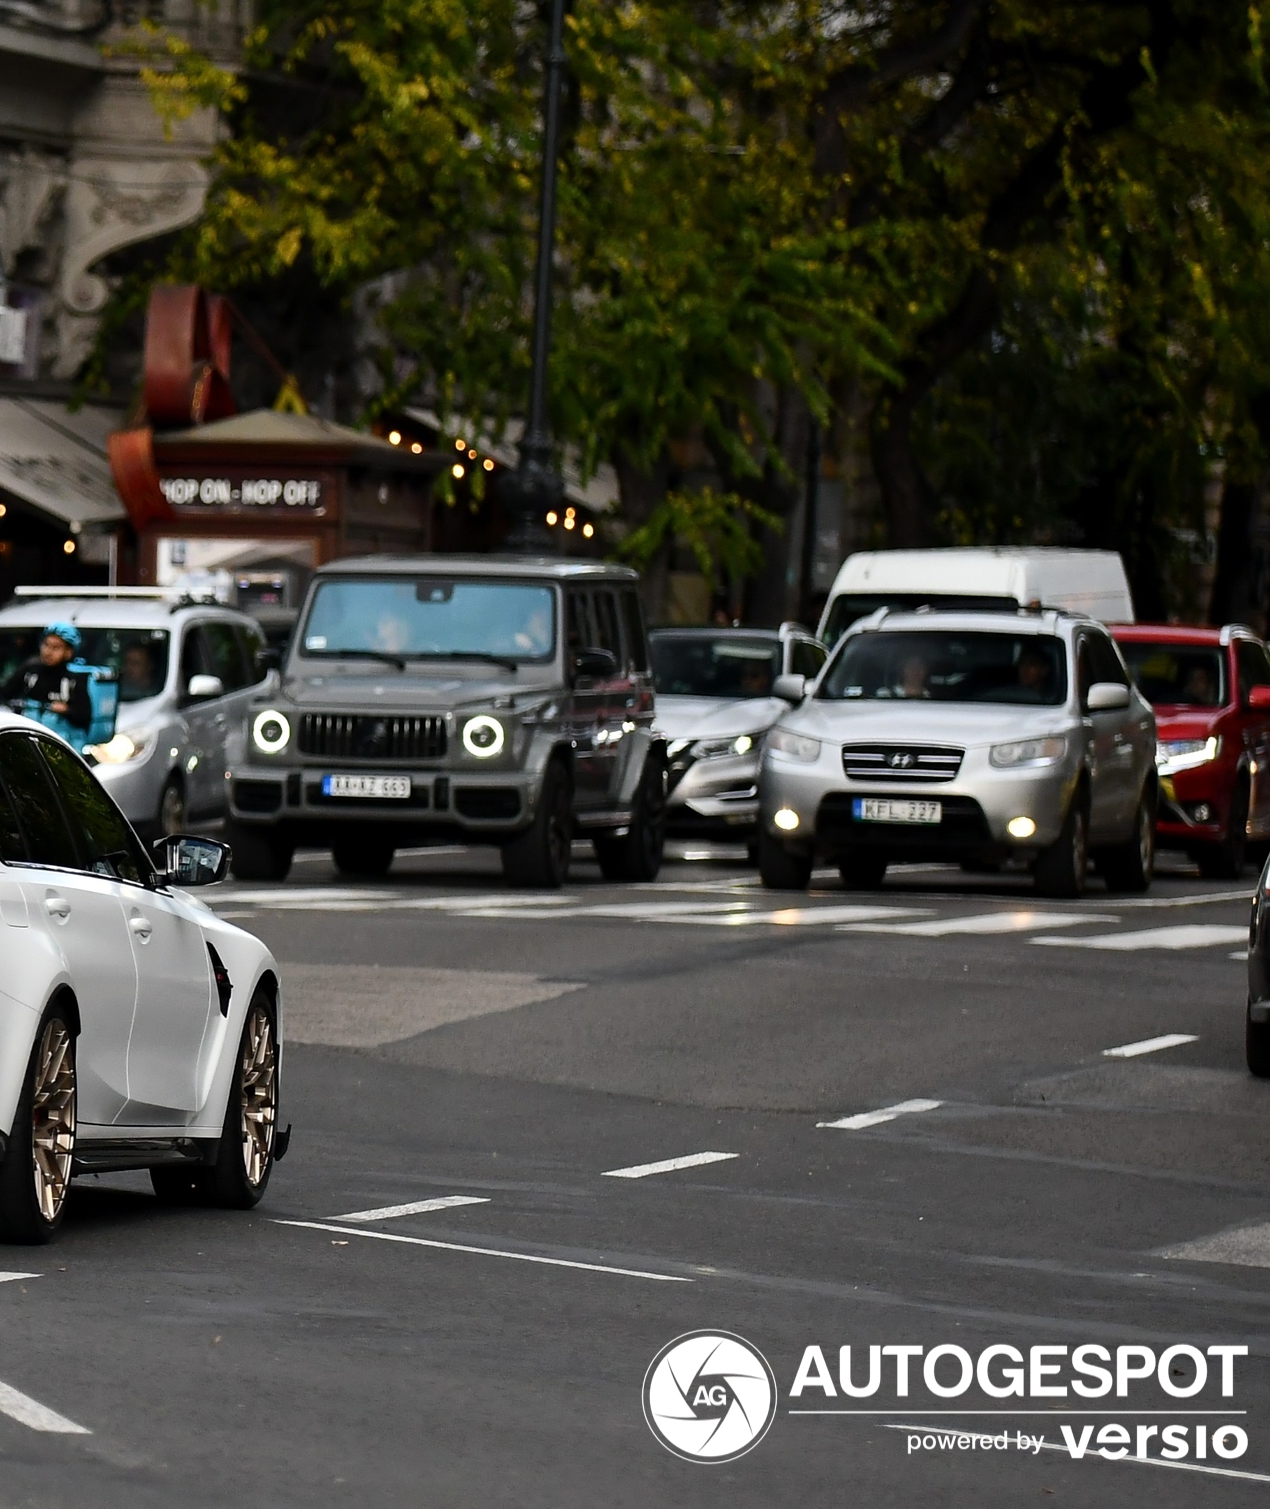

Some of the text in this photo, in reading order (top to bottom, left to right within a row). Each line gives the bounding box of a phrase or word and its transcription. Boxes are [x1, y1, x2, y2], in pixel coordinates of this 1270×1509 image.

[200, 478, 231, 504] ON
[241, 479, 282, 505] HOP
[283, 480, 321, 506] OFF
